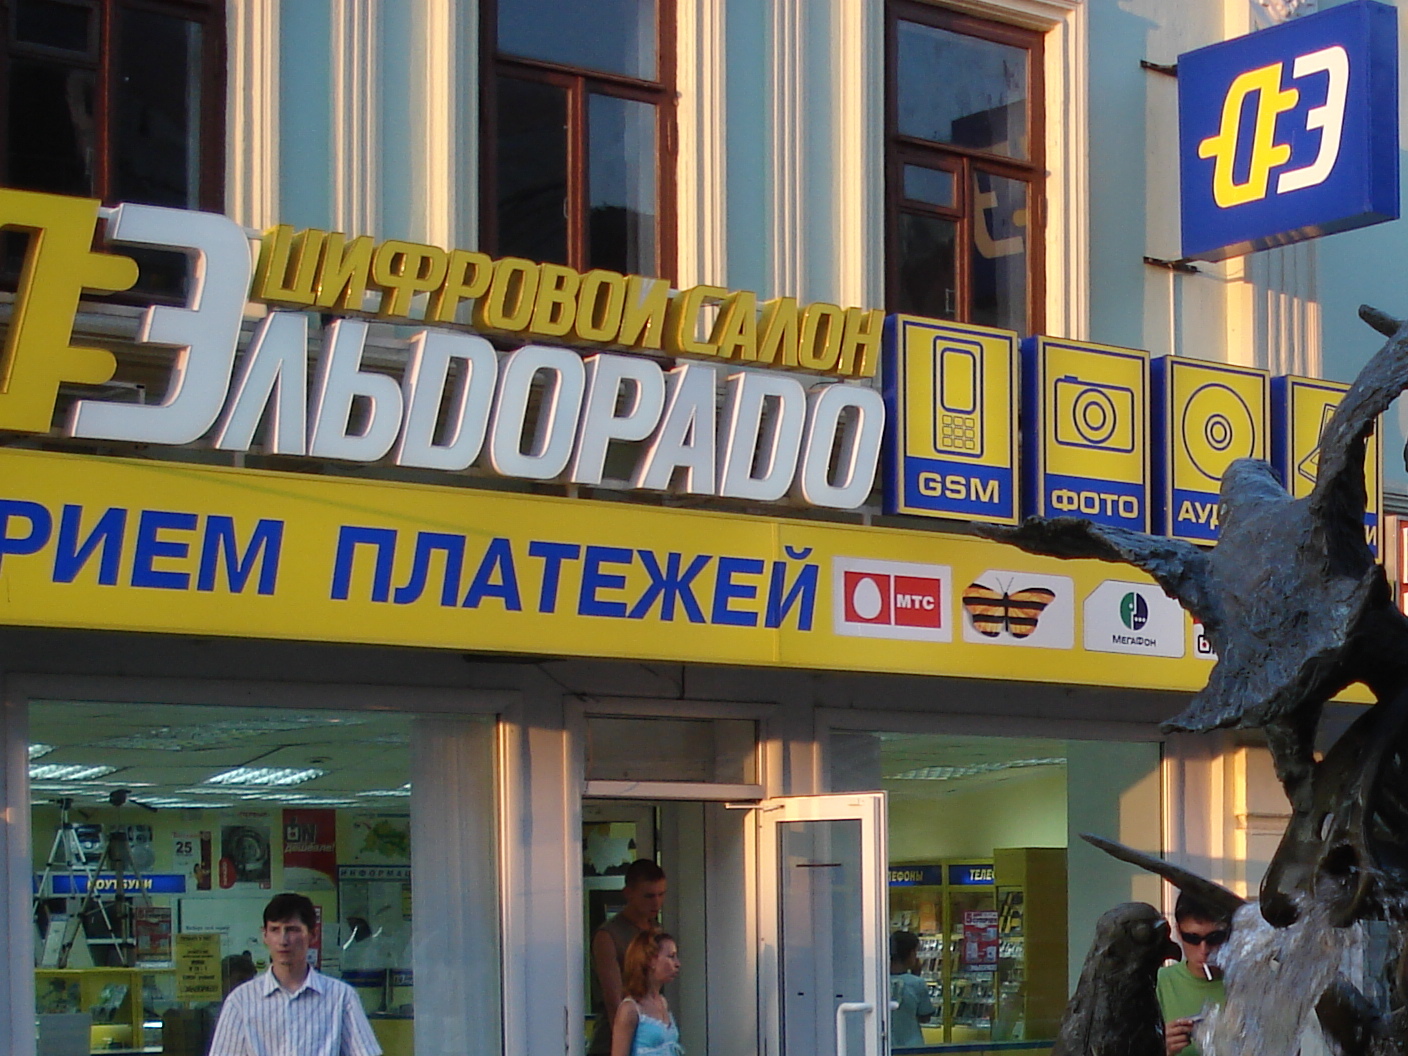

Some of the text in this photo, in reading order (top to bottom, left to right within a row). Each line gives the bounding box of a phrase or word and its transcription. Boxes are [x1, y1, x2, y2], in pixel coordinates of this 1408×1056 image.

[672, 284, 886, 378] САЛОН
[918, 472, 1000, 504] GSM
[1051, 488, 1139, 519] ФОТО
[330, 525, 820, 632] ПЛАТЕЖЕЙ
[896, 594, 935, 609] МТС
[176, 841, 193, 854] 25
